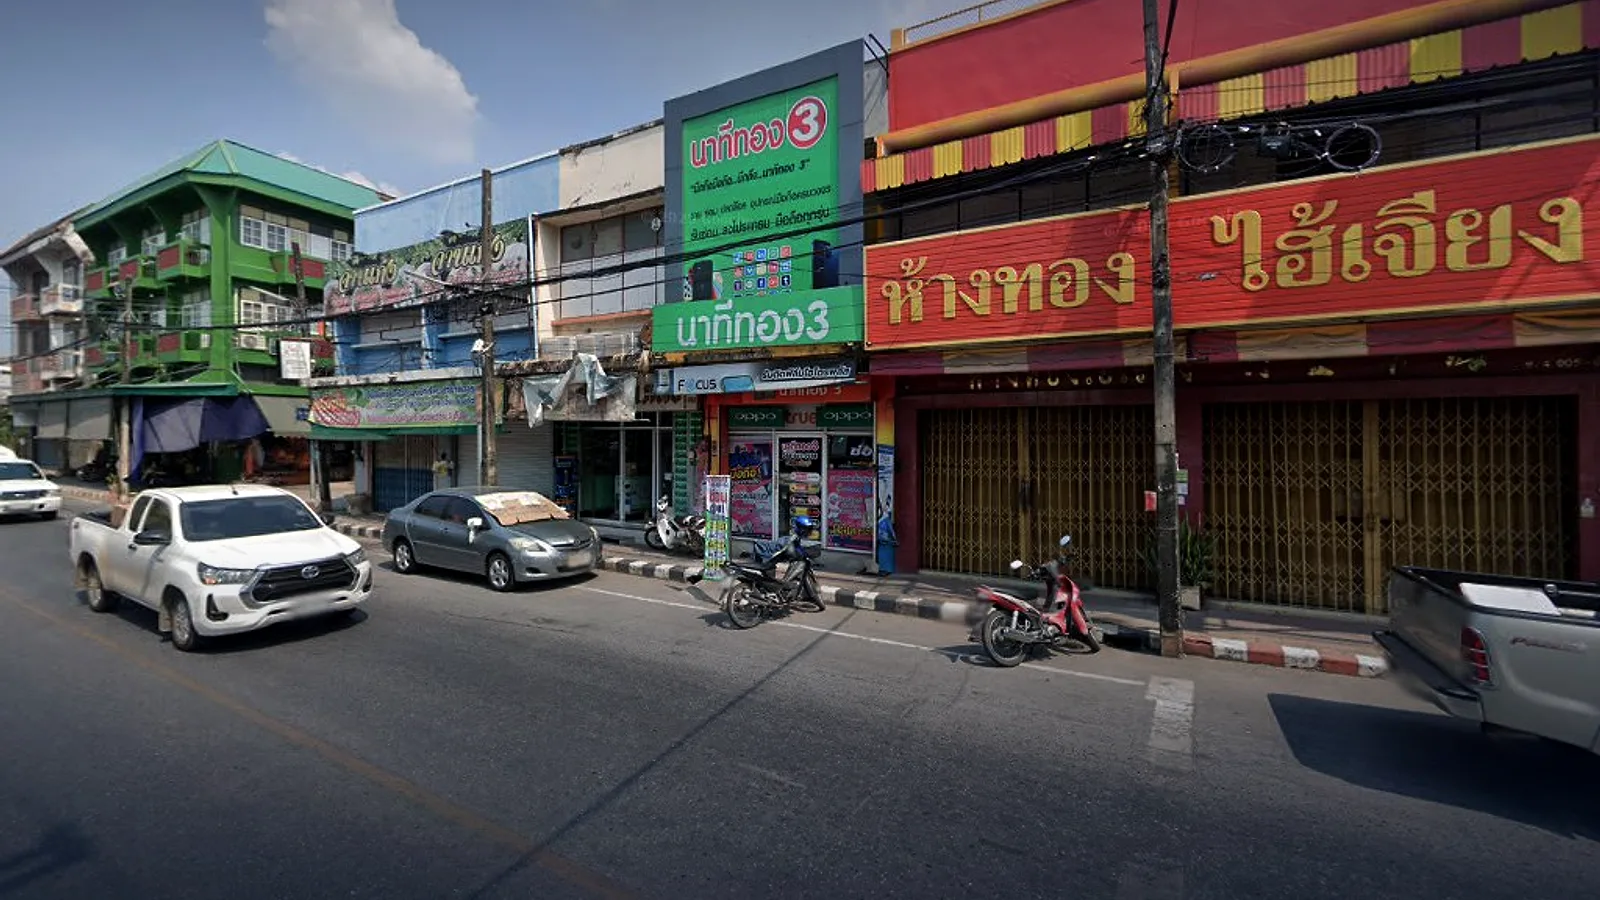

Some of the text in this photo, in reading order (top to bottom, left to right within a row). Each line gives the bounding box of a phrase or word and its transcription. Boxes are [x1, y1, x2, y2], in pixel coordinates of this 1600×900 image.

[691, 96, 822, 167] นาทีทอง 3
[880, 188, 1586, 327] ห้างทอง ไฮ้เจียง
